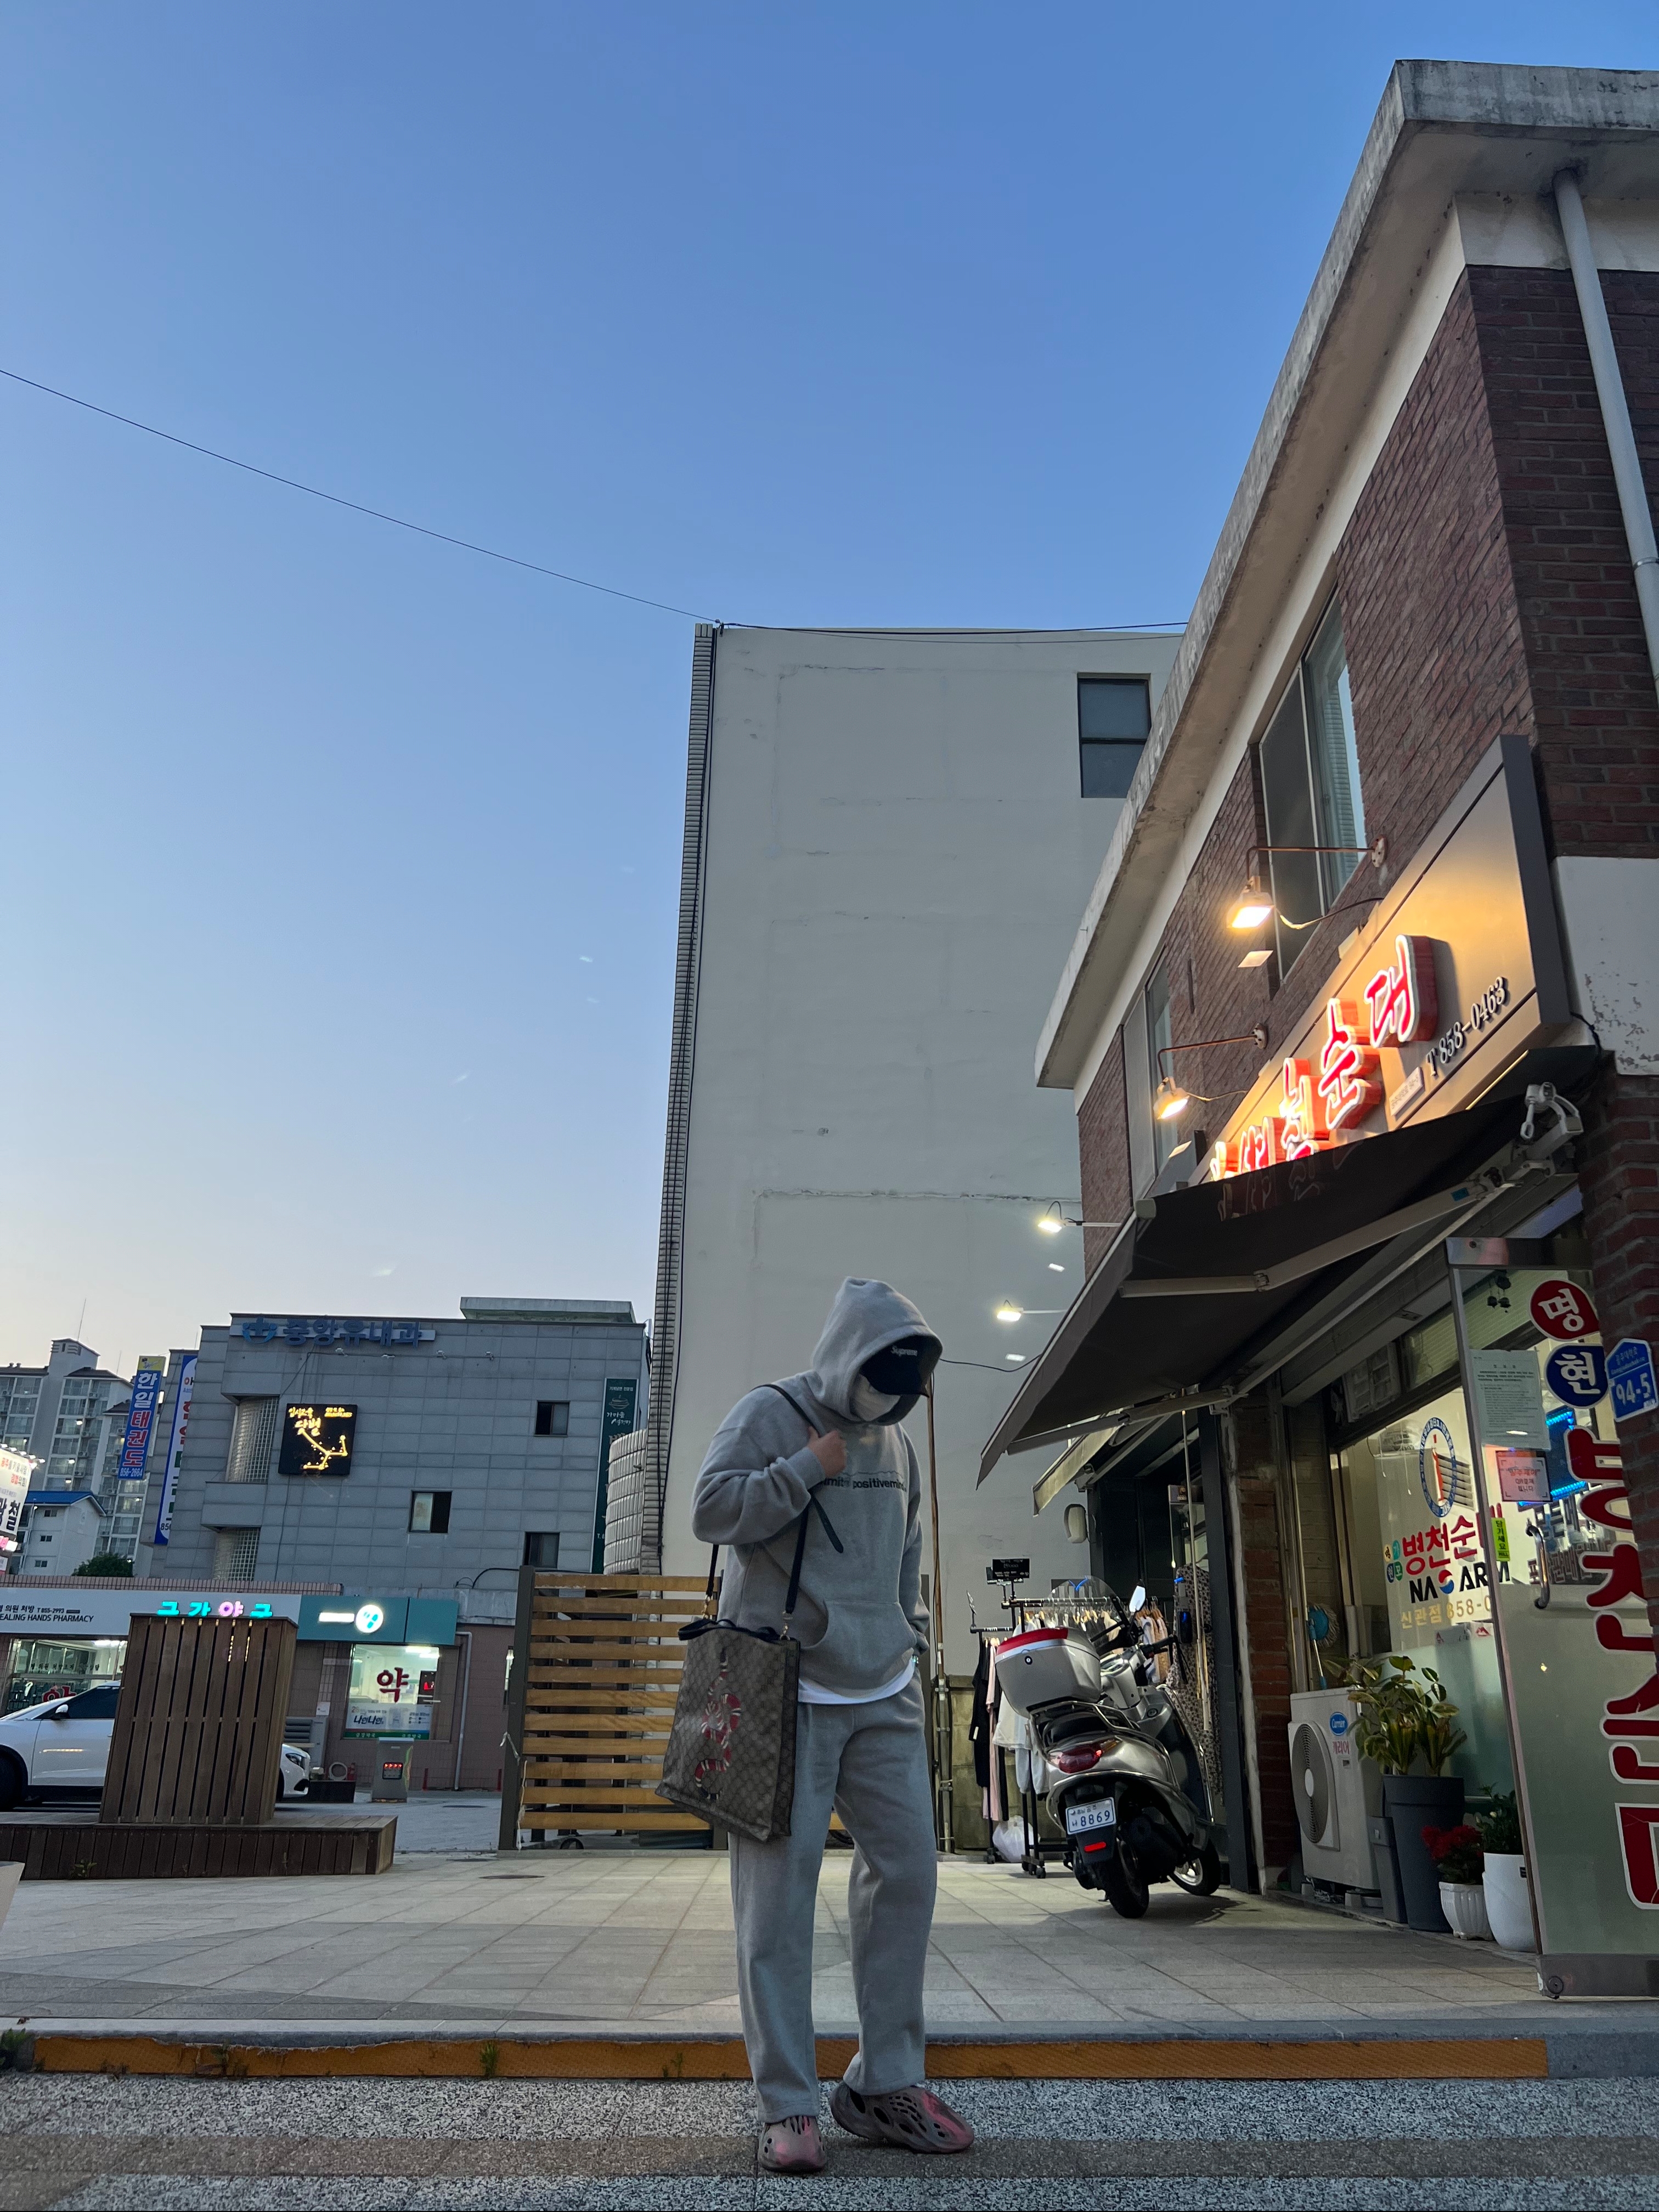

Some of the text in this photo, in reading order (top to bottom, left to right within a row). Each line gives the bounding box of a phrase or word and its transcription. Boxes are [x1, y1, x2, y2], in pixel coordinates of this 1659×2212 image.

[1439, 977, 1505, 1064] 858-0463
[283, 1318, 422, 1348] 중앙유내과
[1616, 1373, 1651, 1405] 94-5
[120, 1468, 143, 1477] 856-2664
[1496, 1520, 1506, 1550] 당기세요
[5, 1605, 19, 1613] 의원
[21, 1605, 34, 1613] 처방
[1401, 1603, 1442, 1629] 신관점
[377, 1667, 409, 1703] 약
[1081, 1810, 1110, 1826] 8869
